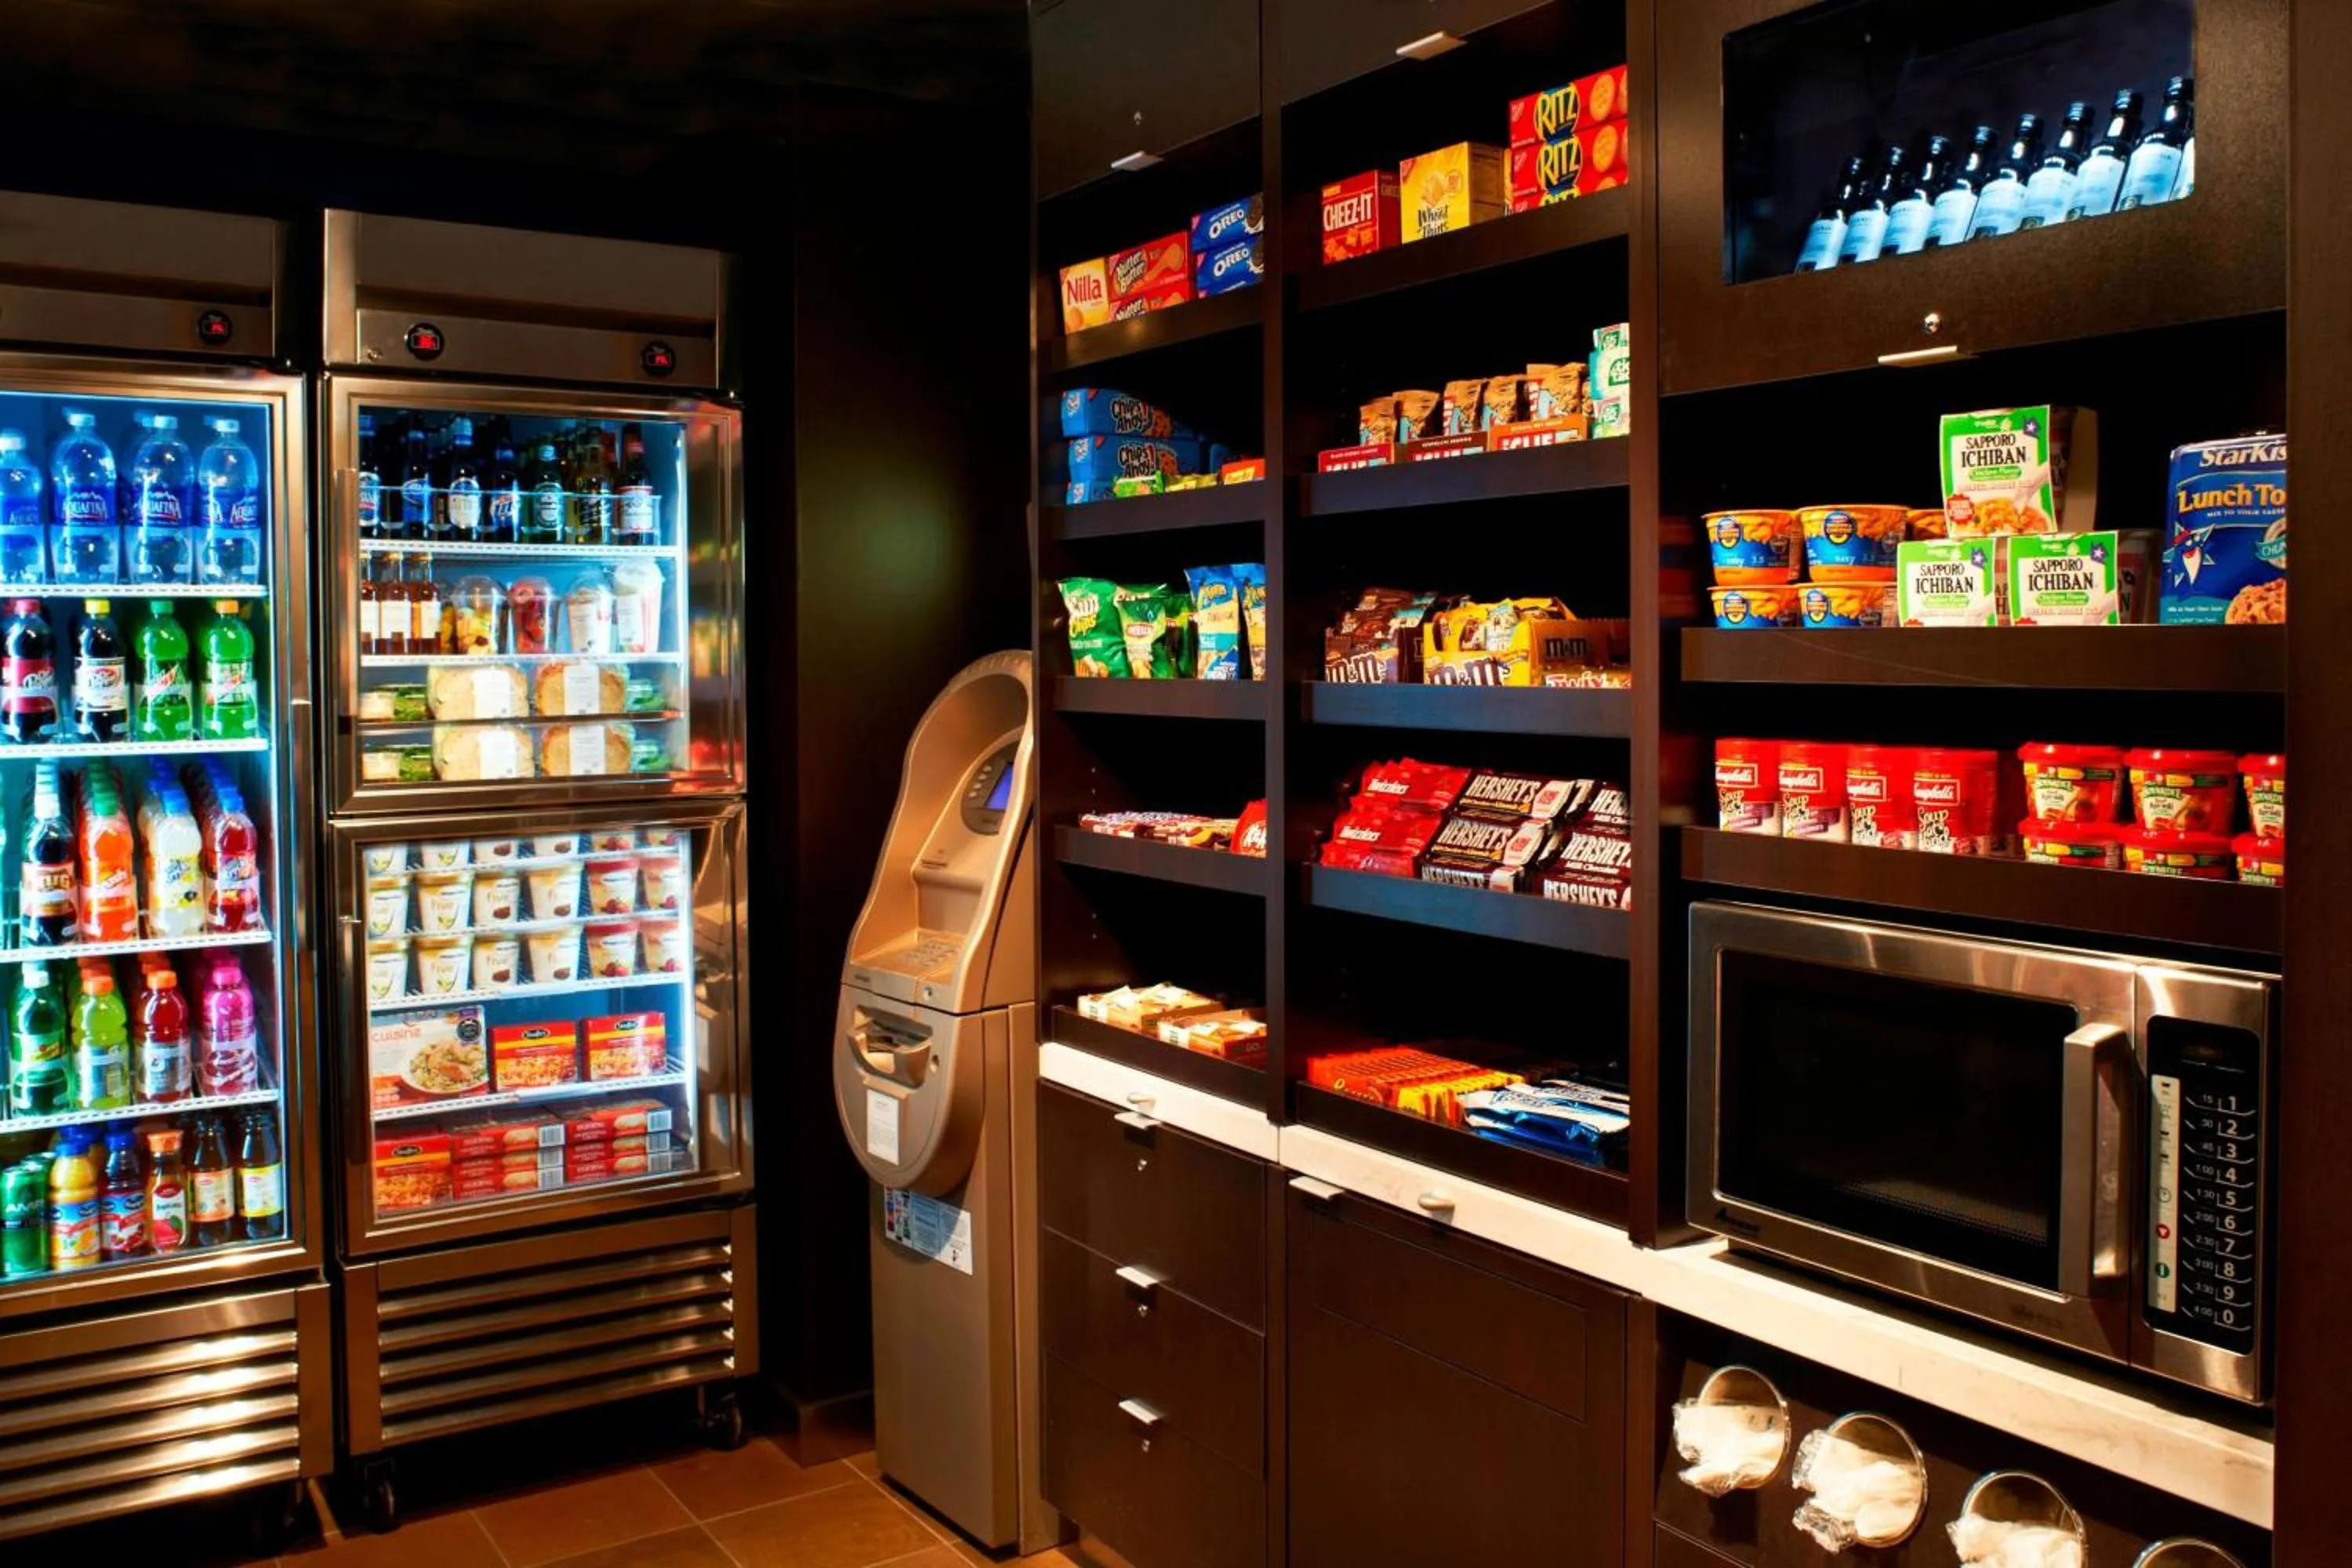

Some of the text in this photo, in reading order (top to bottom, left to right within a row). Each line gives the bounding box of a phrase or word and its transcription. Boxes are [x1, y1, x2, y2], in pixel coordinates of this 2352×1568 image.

[1537, 86, 1577, 135] RITZ
[1538, 138, 1580, 187] RITZ
[1323, 192, 1374, 230] CHEEZ-IT
[1209, 209, 1245, 238] OREO
[1213, 248, 1250, 276] OREO
[1066, 275, 1102, 305] Nilla
[1965, 433, 2016, 450] SAPPORO
[1961, 446, 2027, 468] ICHIBAN
[2199, 444, 2287, 467] StarKis
[2177, 483, 2252, 514] Lunch
[1920, 562, 1965, 577] SAPPORO
[2033, 557, 2084, 573] SAPPORO
[1915, 575, 1974, 593] ICHIBAN
[2028, 572, 2093, 591] ICHIBAN
[1465, 774, 1541, 803] HERSHEY'S
[1439, 818, 1513, 848] HERSHEY'S
[1544, 879, 1617, 908] HERSHEY'S
[373, 1028, 422, 1042] cuisine
[2230, 1095, 2237, 1111] 1
[2226, 1120, 2238, 1134] 2
[2226, 1143, 2237, 1159] 3
[2226, 1167, 2237, 1182] 4
[2226, 1191, 2237, 1206] 5
[2224, 1215, 2236, 1230] 6
[2224, 1238, 2235, 1253] 7
[2223, 1261, 2235, 1277] 8
[2223, 1285, 2234, 1301] 9
[2223, 1308, 2234, 1324] 0
